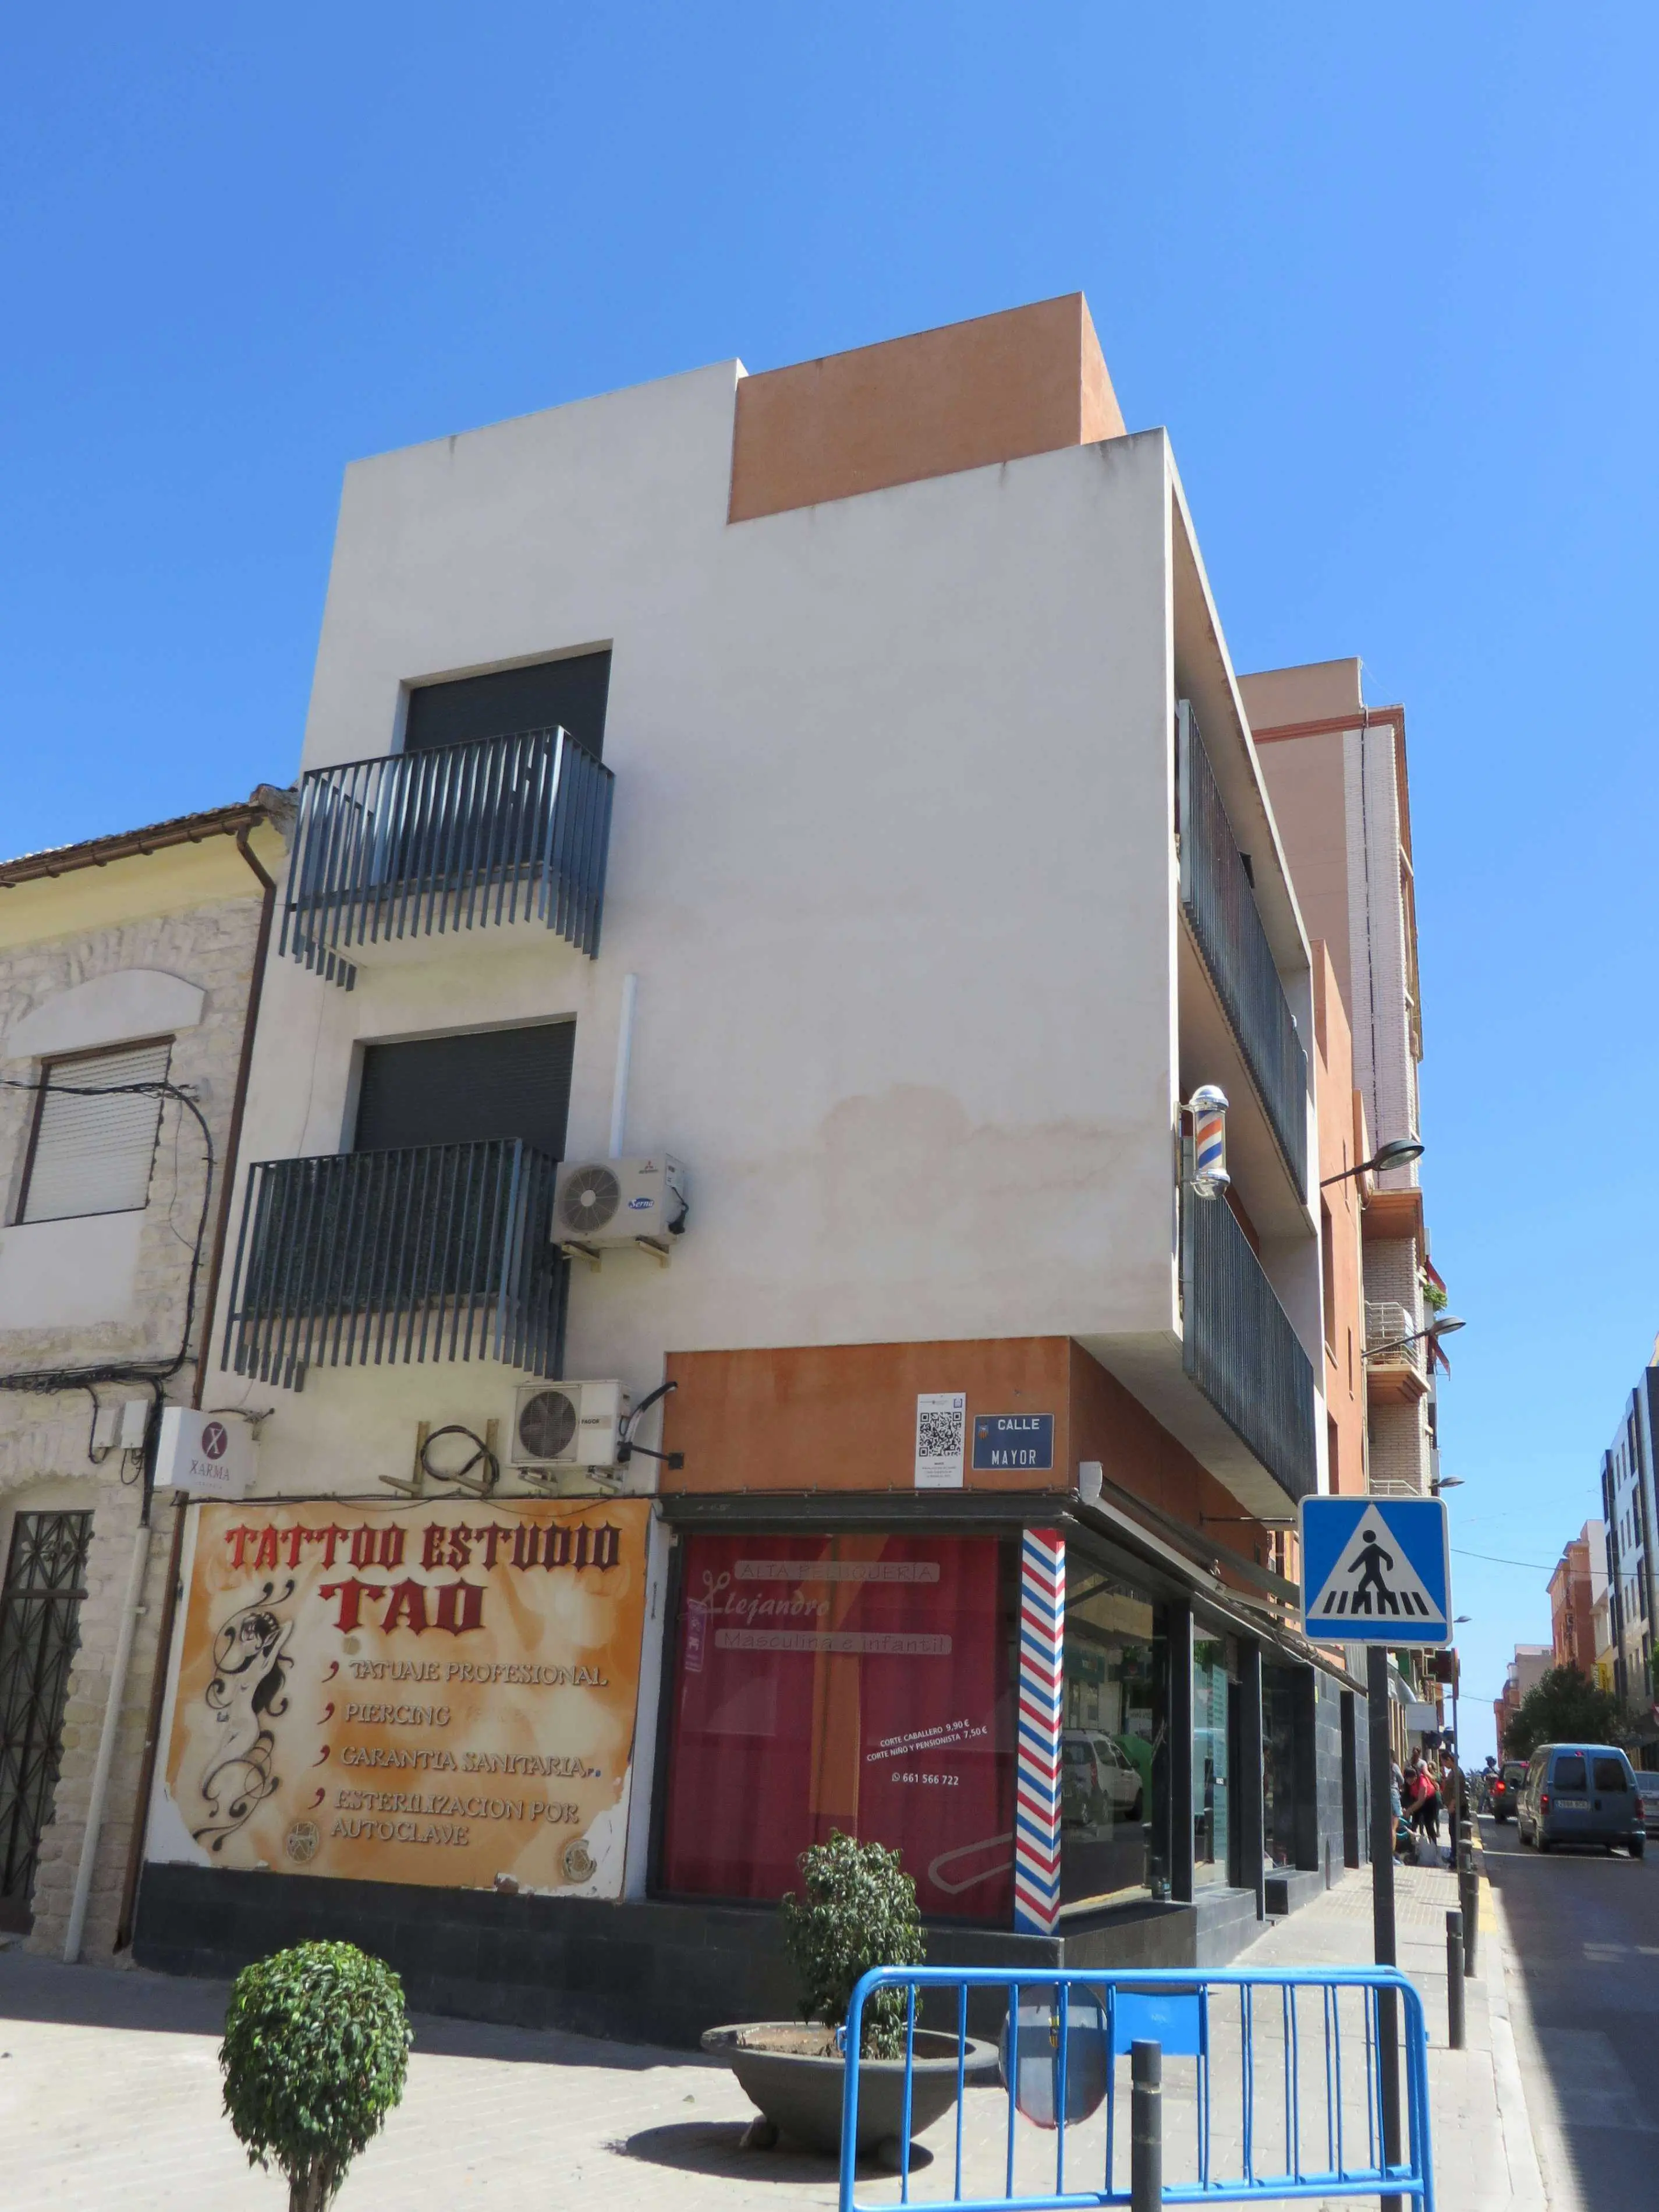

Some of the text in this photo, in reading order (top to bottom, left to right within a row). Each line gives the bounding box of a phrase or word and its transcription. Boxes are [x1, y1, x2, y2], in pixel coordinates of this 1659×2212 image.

[630, 1199, 654, 1208] Serna
[998, 1418, 1040, 1431] CALLE
[991, 1449, 1036, 1466] MAYOR
[189, 1458, 230, 1481] XARMA
[225, 1520, 623, 1572] TATTOO ESTUDIO
[740, 1563, 789, 1579] ALTA
[318, 1576, 489, 1637] TAO
[724, 1632, 833, 1651] Masculina
[862, 1634, 944, 1654] infantil
[349, 1659, 609, 1686] TATUAJE PROFESIONAL
[345, 1703, 452, 1726] PIERCING
[866, 1753, 889, 1762] CORTE
[891, 1746, 909, 1757] NIÑO
[916, 1733, 961, 1750] PENSIONISTA
[880, 1737, 902, 1747] CORTE
[903, 1726, 944, 1742] CABALLERO
[339, 1746, 587, 1778] GARANTIA SANITARIA
[902, 1773, 959, 1786] 661 566 722
[334, 1788, 579, 1824] ESTERILIZACION POR
[331, 1817, 470, 1846] AUTOCLAVE
